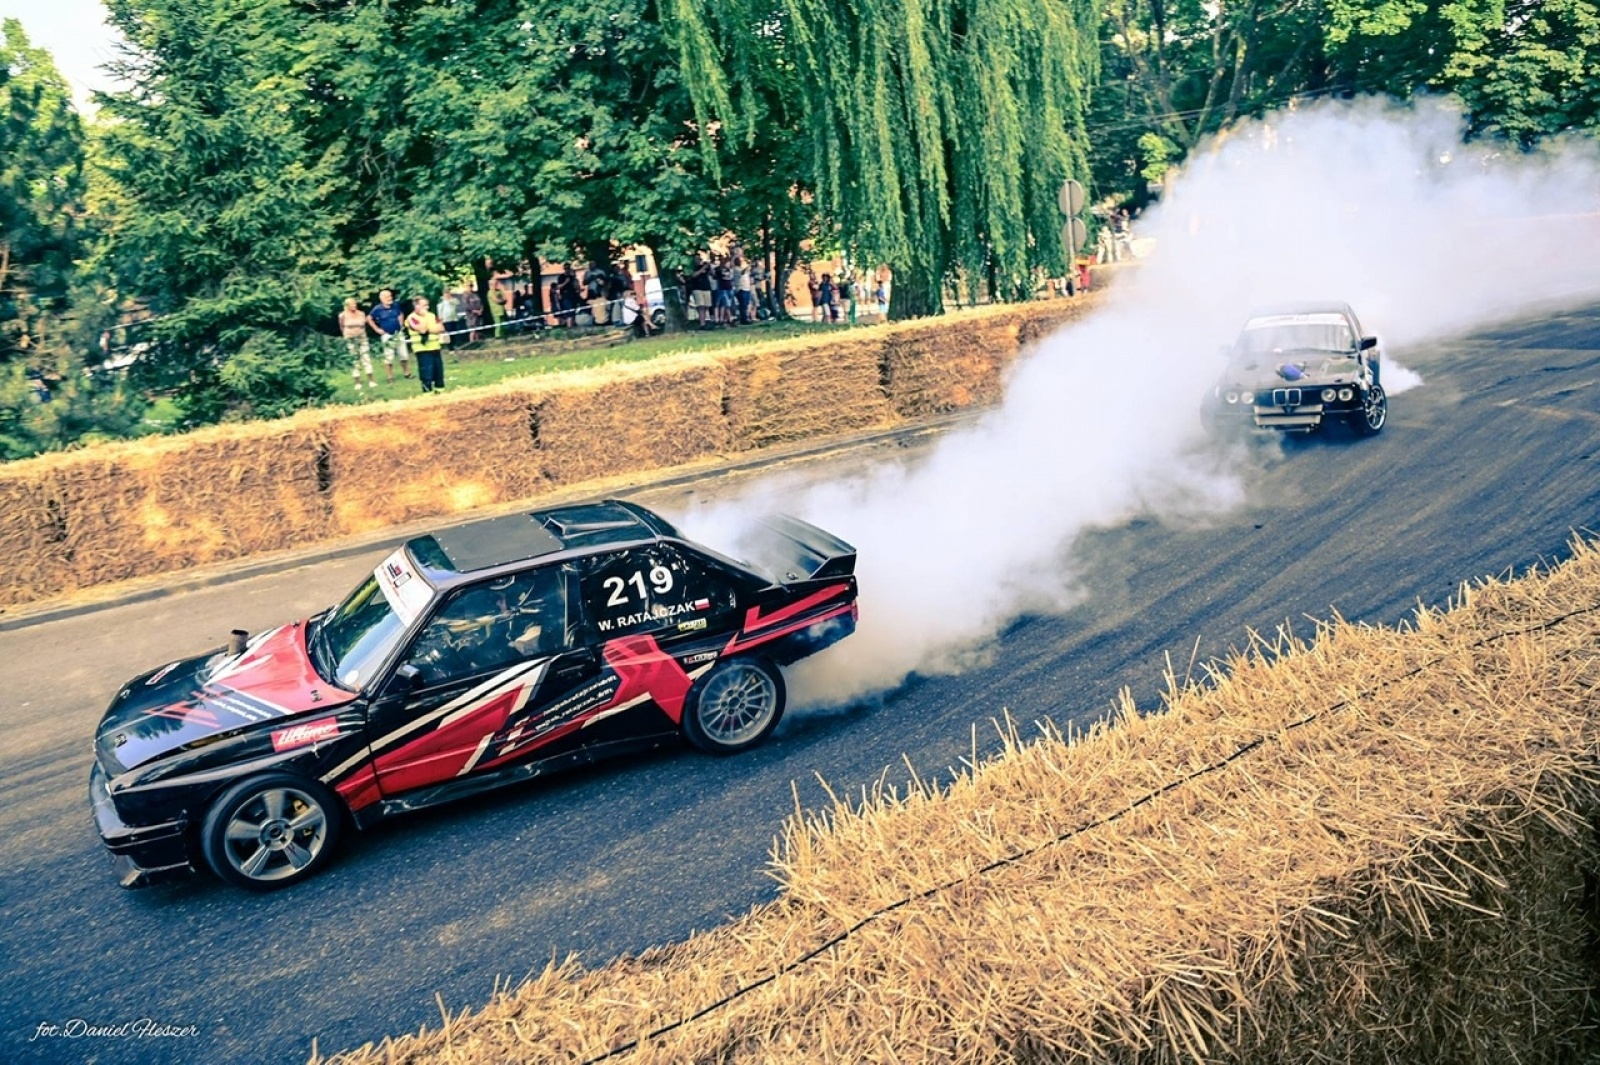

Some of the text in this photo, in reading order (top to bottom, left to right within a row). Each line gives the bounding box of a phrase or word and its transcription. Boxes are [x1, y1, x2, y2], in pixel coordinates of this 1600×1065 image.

[603, 566, 674, 607] 219
[598, 619, 615, 632] W.
[617, 601, 695, 628] RATAJCZAK
